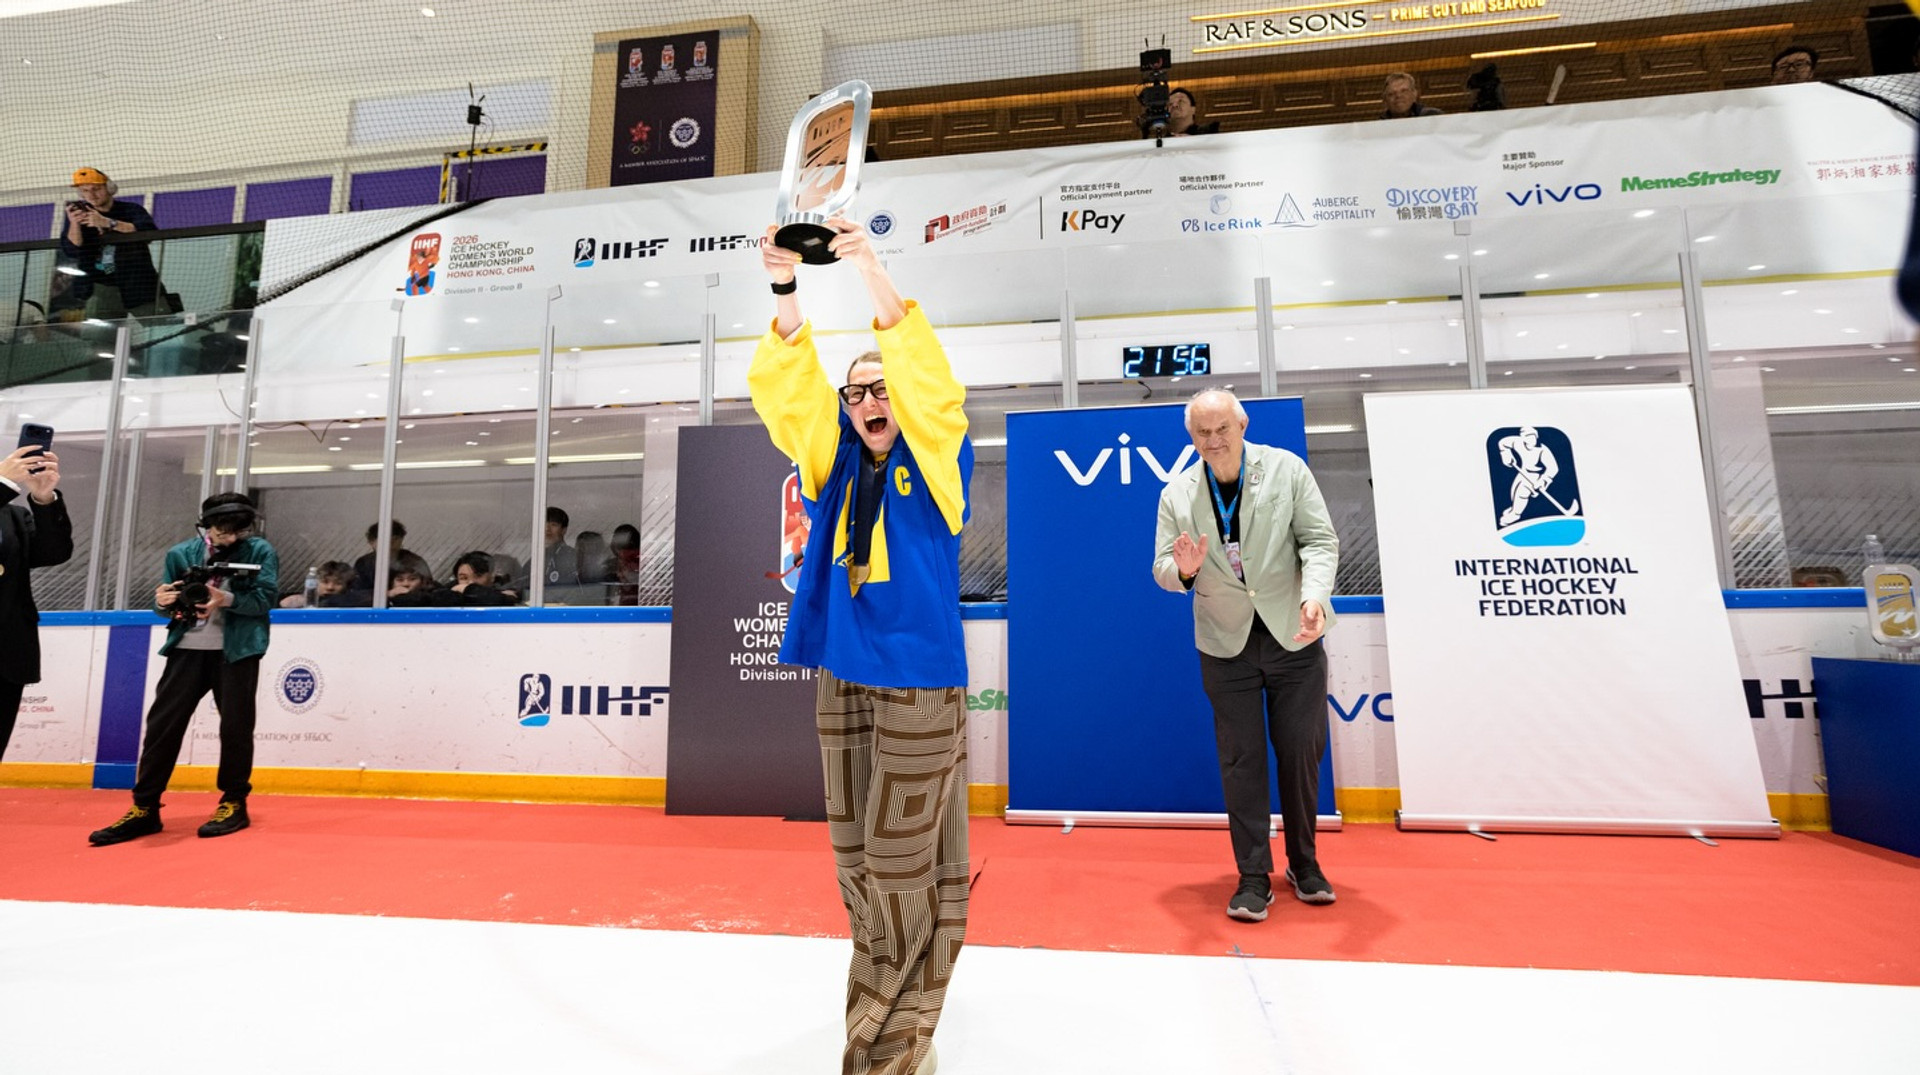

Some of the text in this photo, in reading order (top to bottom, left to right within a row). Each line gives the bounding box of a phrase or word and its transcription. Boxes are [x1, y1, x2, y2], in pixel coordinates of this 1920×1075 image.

[1390, 7, 1430, 22] PRIME
[1432, 3, 1457, 18] CUT
[1460, 1, 1486, 16] AND
[1205, 9, 1367, 42] RAF & SONS
[1503, 160, 1564, 171] Major Sponsor
[1180, 180, 1265, 192] Official Venue Partner
[1621, 168, 1782, 192] MemeStrategy
[1060, 188, 1153, 202] Official payment partner
[1505, 183, 1602, 207] vivo
[1061, 209, 1126, 234] KPay
[413, 238, 438, 250] IIHF
[450, 241, 510, 253] ICE HOCKEY
[452, 234, 479, 246] 2026
[449, 246, 534, 262] WOMEN'S WORLD
[601, 237, 669, 261] IIHF
[448, 256, 524, 271] CHAMPIONSHIP
[446, 265, 535, 279] HONG KONG, CHINA
[444, 286, 476, 296] Division
[1054, 432, 1200, 487] viv
[894, 466, 912, 497] C
[1455, 557, 1639, 576] INTERNATIONAL
[1481, 577, 1617, 596] ICE HOCKEY
[758, 602, 788, 617] ICE
[1479, 597, 1627, 616] FEDERATION
[733, 617, 789, 633] WOME
[730, 652, 779, 666] HONG
[740, 668, 797, 681] Division
[801, 668, 811, 681] II
[561, 685, 671, 716] IIHF
